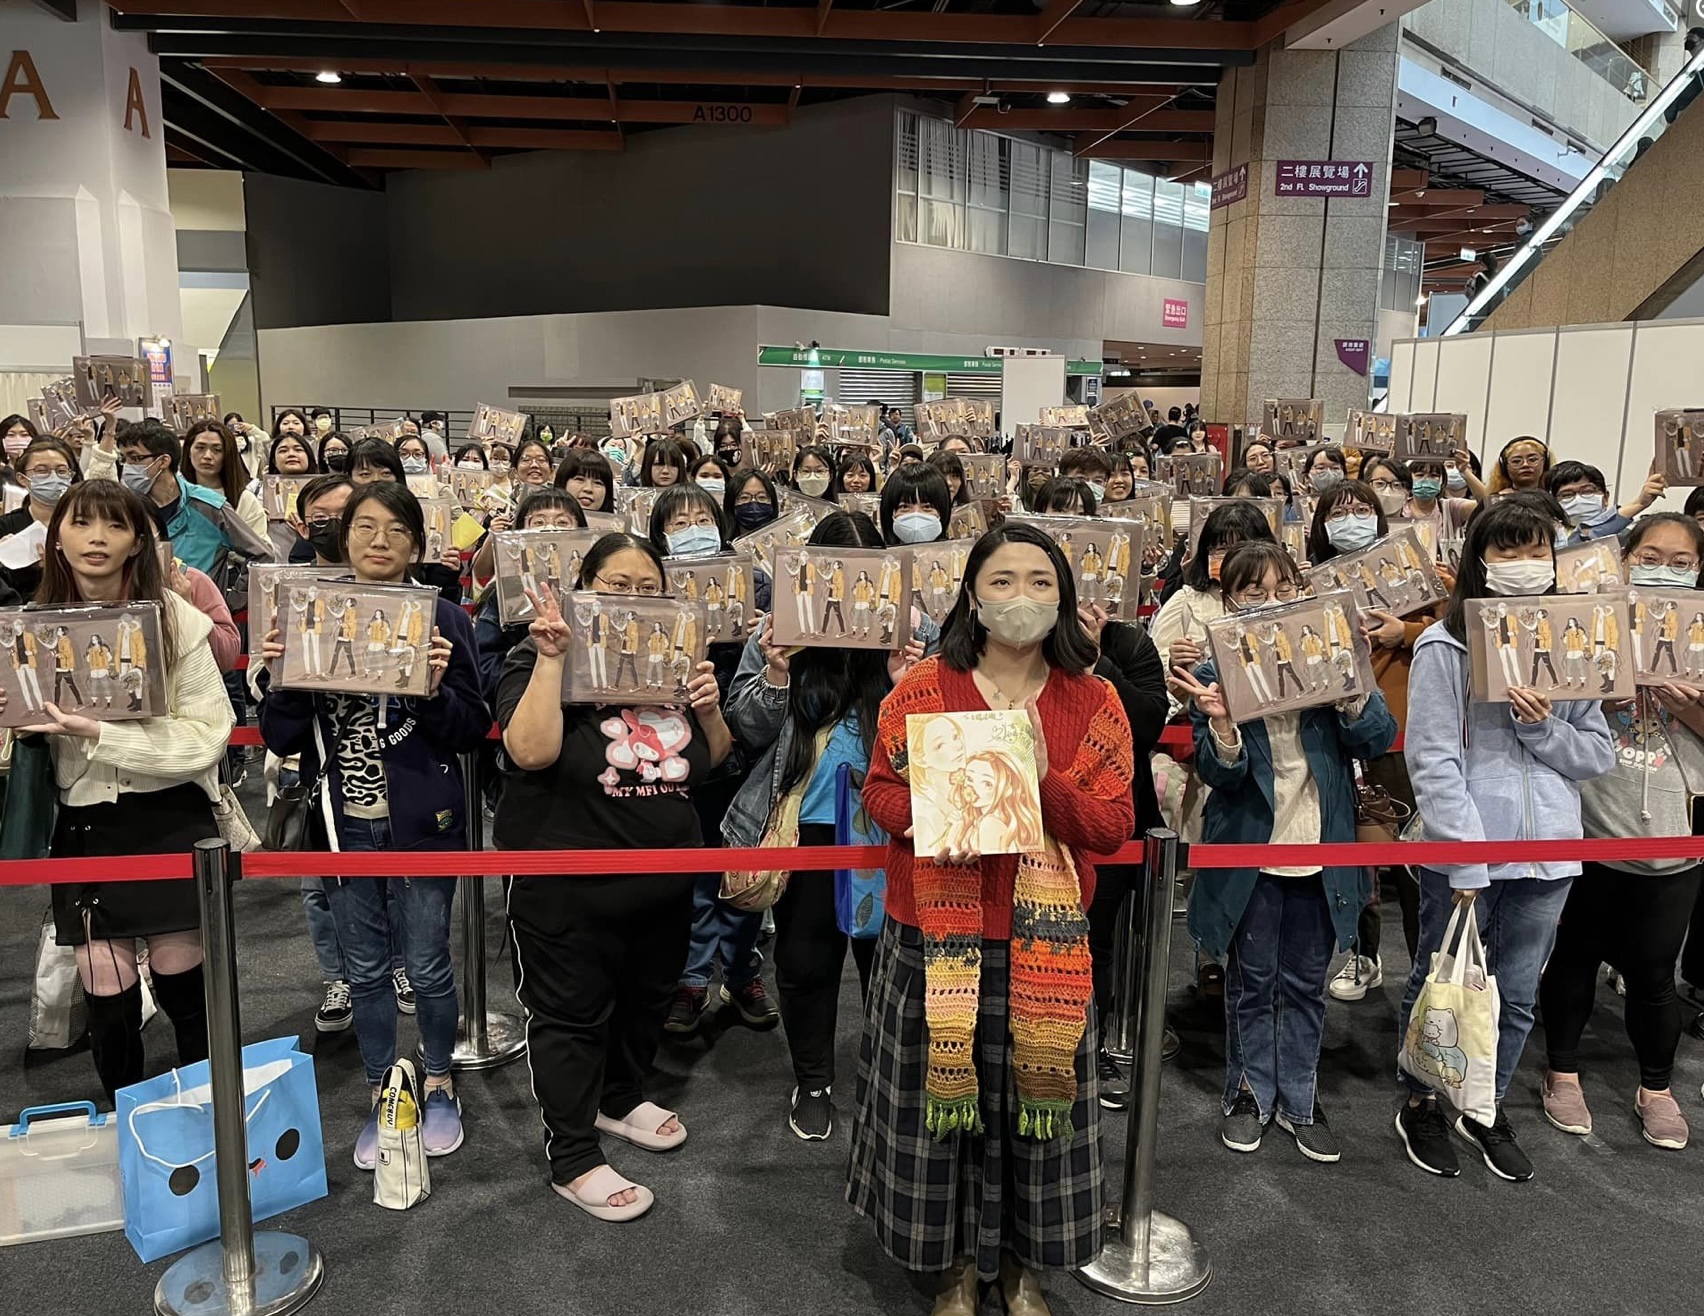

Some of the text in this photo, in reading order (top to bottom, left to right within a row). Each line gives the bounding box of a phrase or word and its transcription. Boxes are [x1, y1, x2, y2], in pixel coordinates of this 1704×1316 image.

[0, 50, 60, 119] A
[124, 67, 151, 139] A
[693, 105, 752, 122] A1300
[1281, 165, 1349, 178] 二樓展覽場
[1280, 183, 1293, 191] 2nd
[1308, 183, 1349, 192] Showground
[388, 717, 417, 745] GOODS
[611, 786, 634, 797] MY
